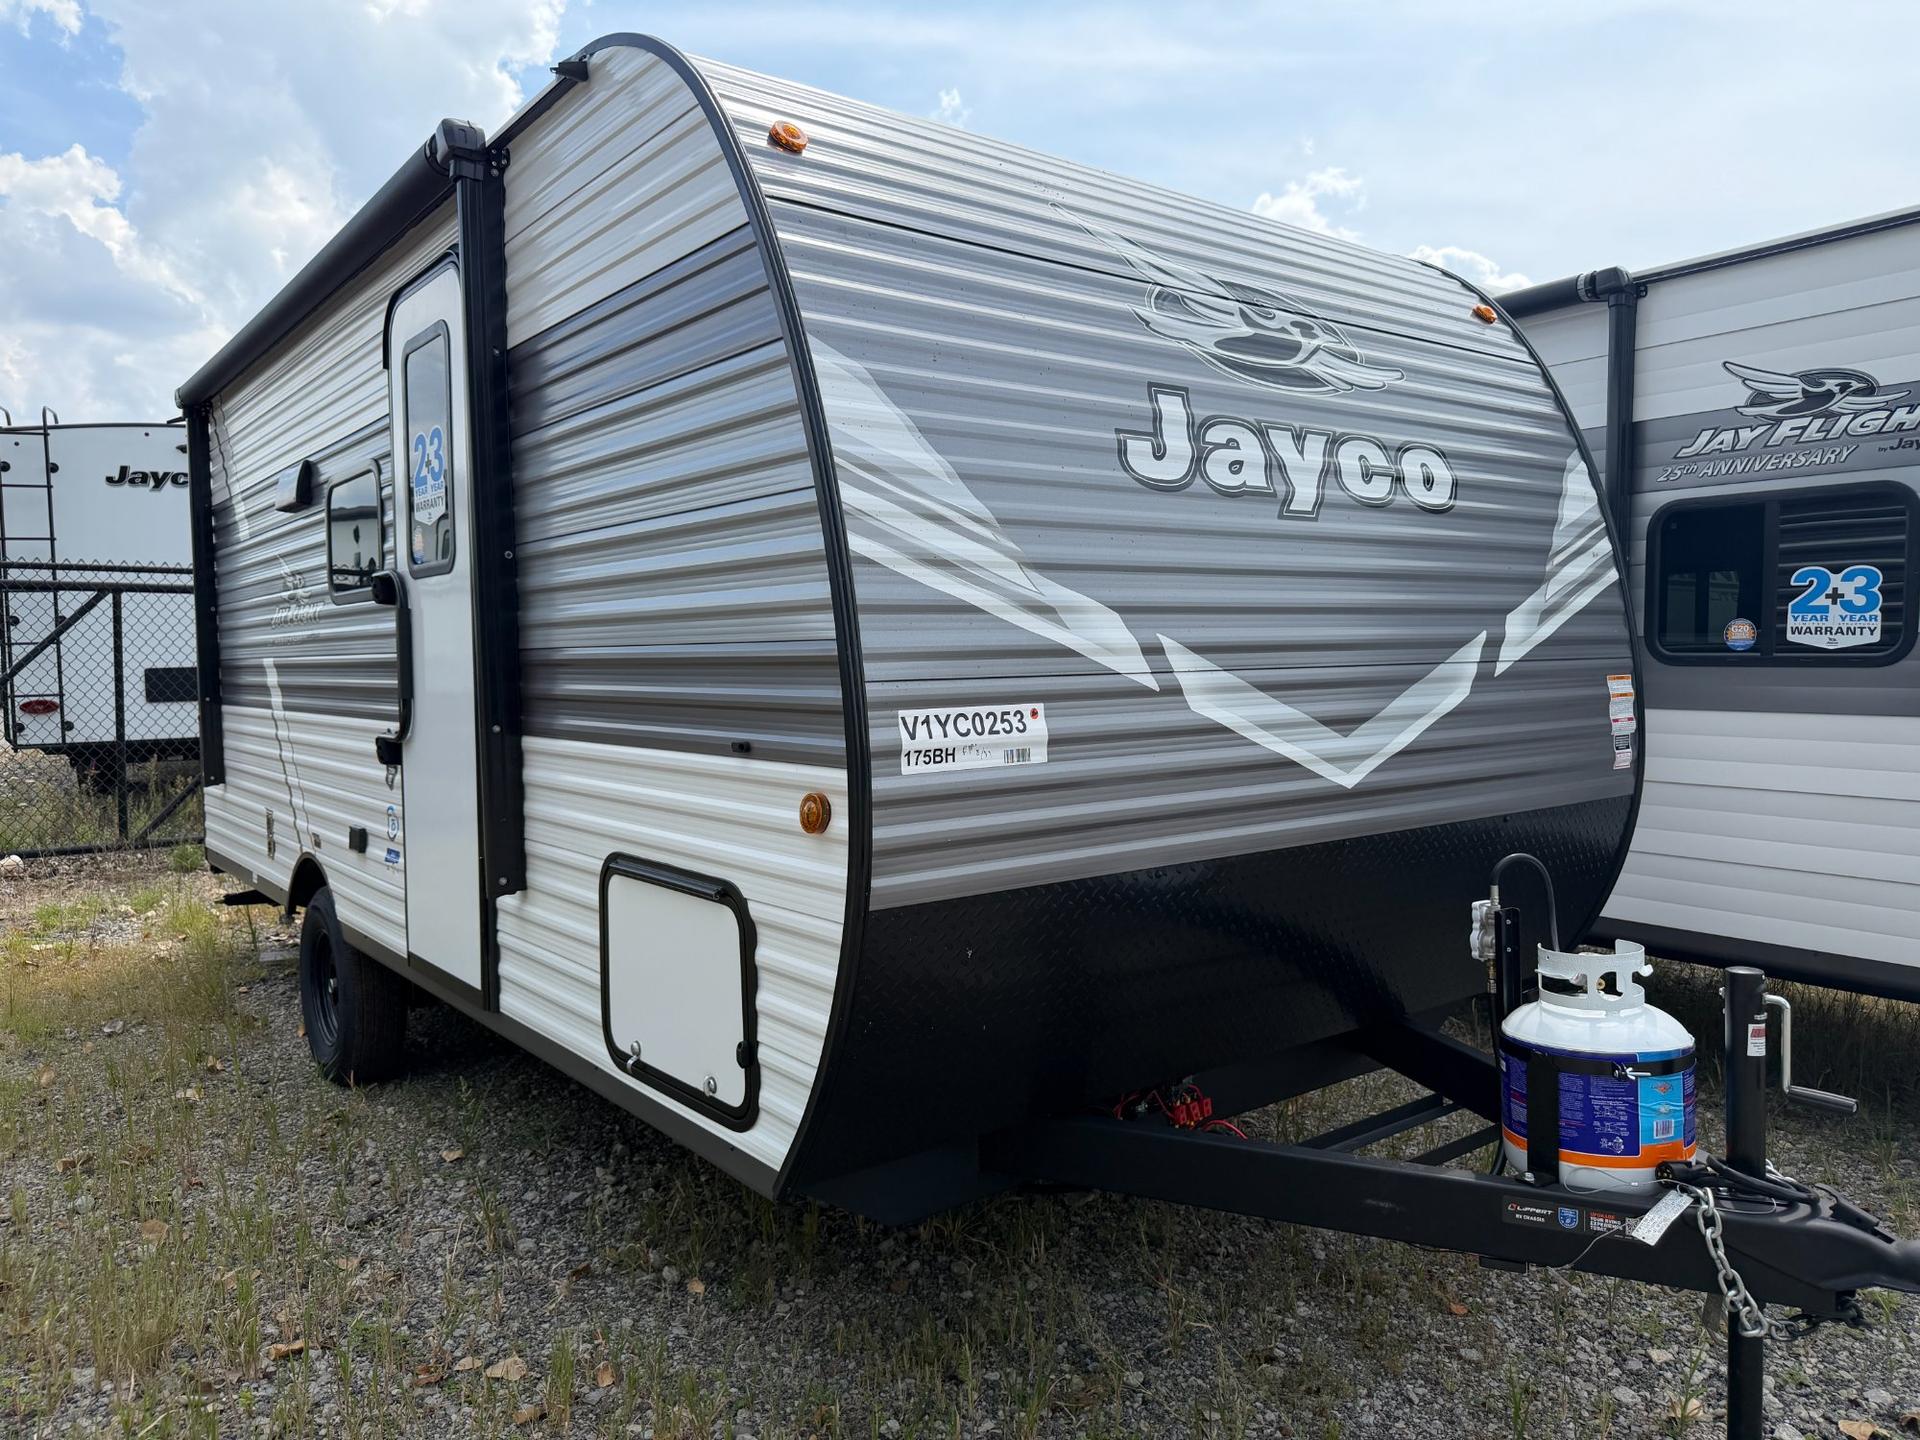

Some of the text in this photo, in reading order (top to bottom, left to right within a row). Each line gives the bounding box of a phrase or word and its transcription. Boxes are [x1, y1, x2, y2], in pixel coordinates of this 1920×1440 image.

[1674, 405, 1920, 459] JAY FLIGH
[1114, 381, 1458, 521] Jayco
[1656, 445, 1858, 482] 25th ANNIVERSARY
[416, 480, 444, 498] YEAR YEAR
[416, 496, 444, 512] WARRANTY
[1791, 614, 1879, 622] YEAR YEAR
[1790, 626, 1878, 636] WARRANTY
[900, 709, 1027, 741] V1YC0253
[903, 747, 956, 767] 175BH
